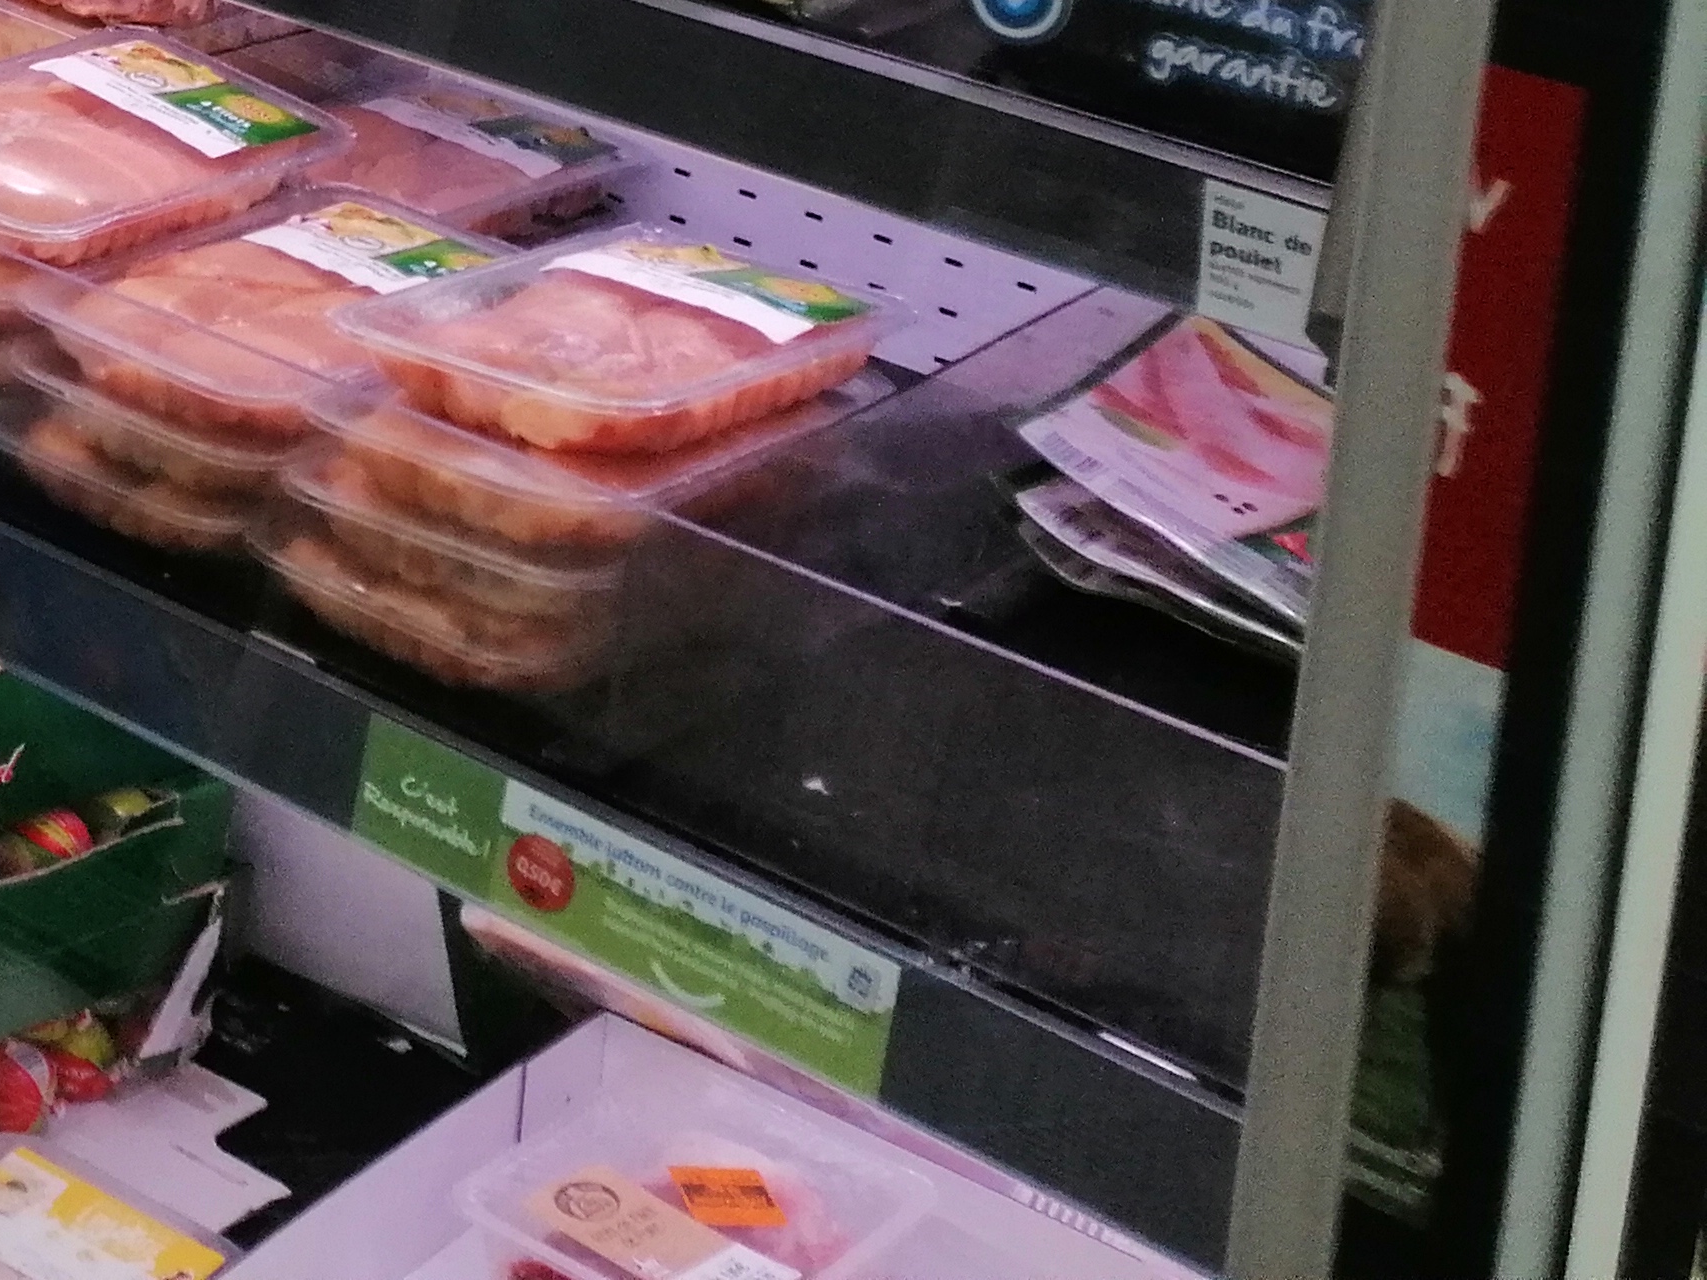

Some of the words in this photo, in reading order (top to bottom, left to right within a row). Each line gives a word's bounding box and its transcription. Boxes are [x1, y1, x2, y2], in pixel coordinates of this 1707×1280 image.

[1147, 39, 1337, 109] garantie
[1210, 241, 1282, 275] poulet
[1212, 209, 1274, 244] Blanc
[1284, 234, 1312, 256] de
[529, 803, 601, 851] Ensemble
[603, 839, 662, 880] luttons
[666, 872, 717, 907] contre
[720, 895, 737, 916] le
[738, 909, 829, 961] gaspillage
